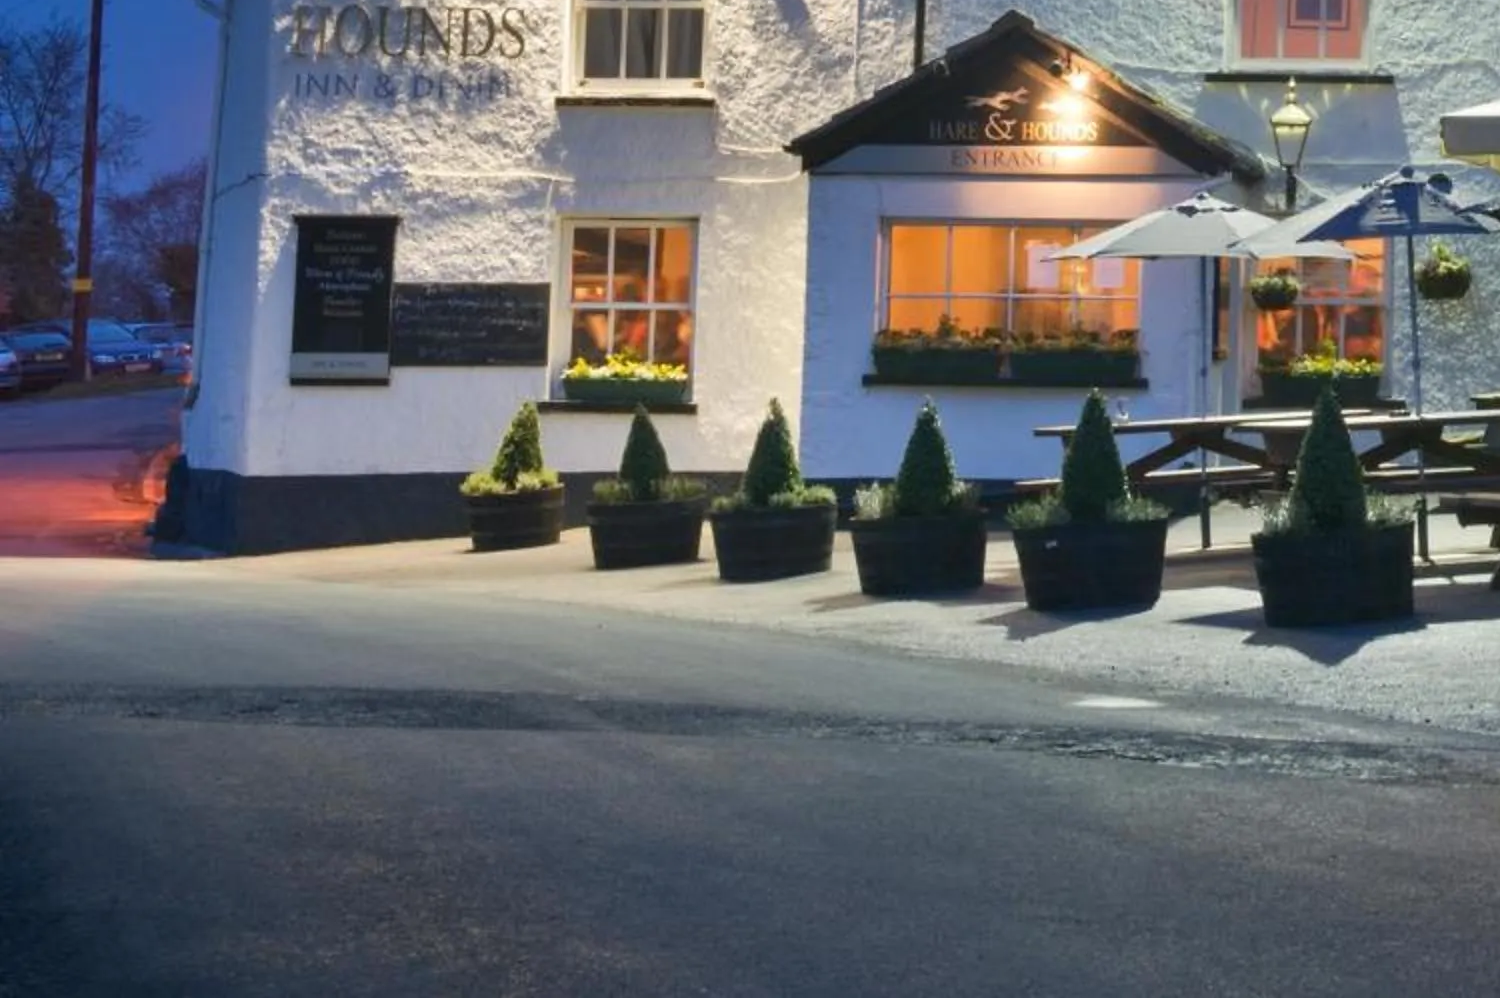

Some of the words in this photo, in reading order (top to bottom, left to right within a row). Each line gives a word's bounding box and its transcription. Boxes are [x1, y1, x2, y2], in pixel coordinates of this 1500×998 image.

[290, 3, 527, 59] HOUNDS
[294, 73, 359, 98] INN
[374, 73, 396, 100] &
[929, 120, 979, 141] HARE
[984, 111, 1017, 141] &
